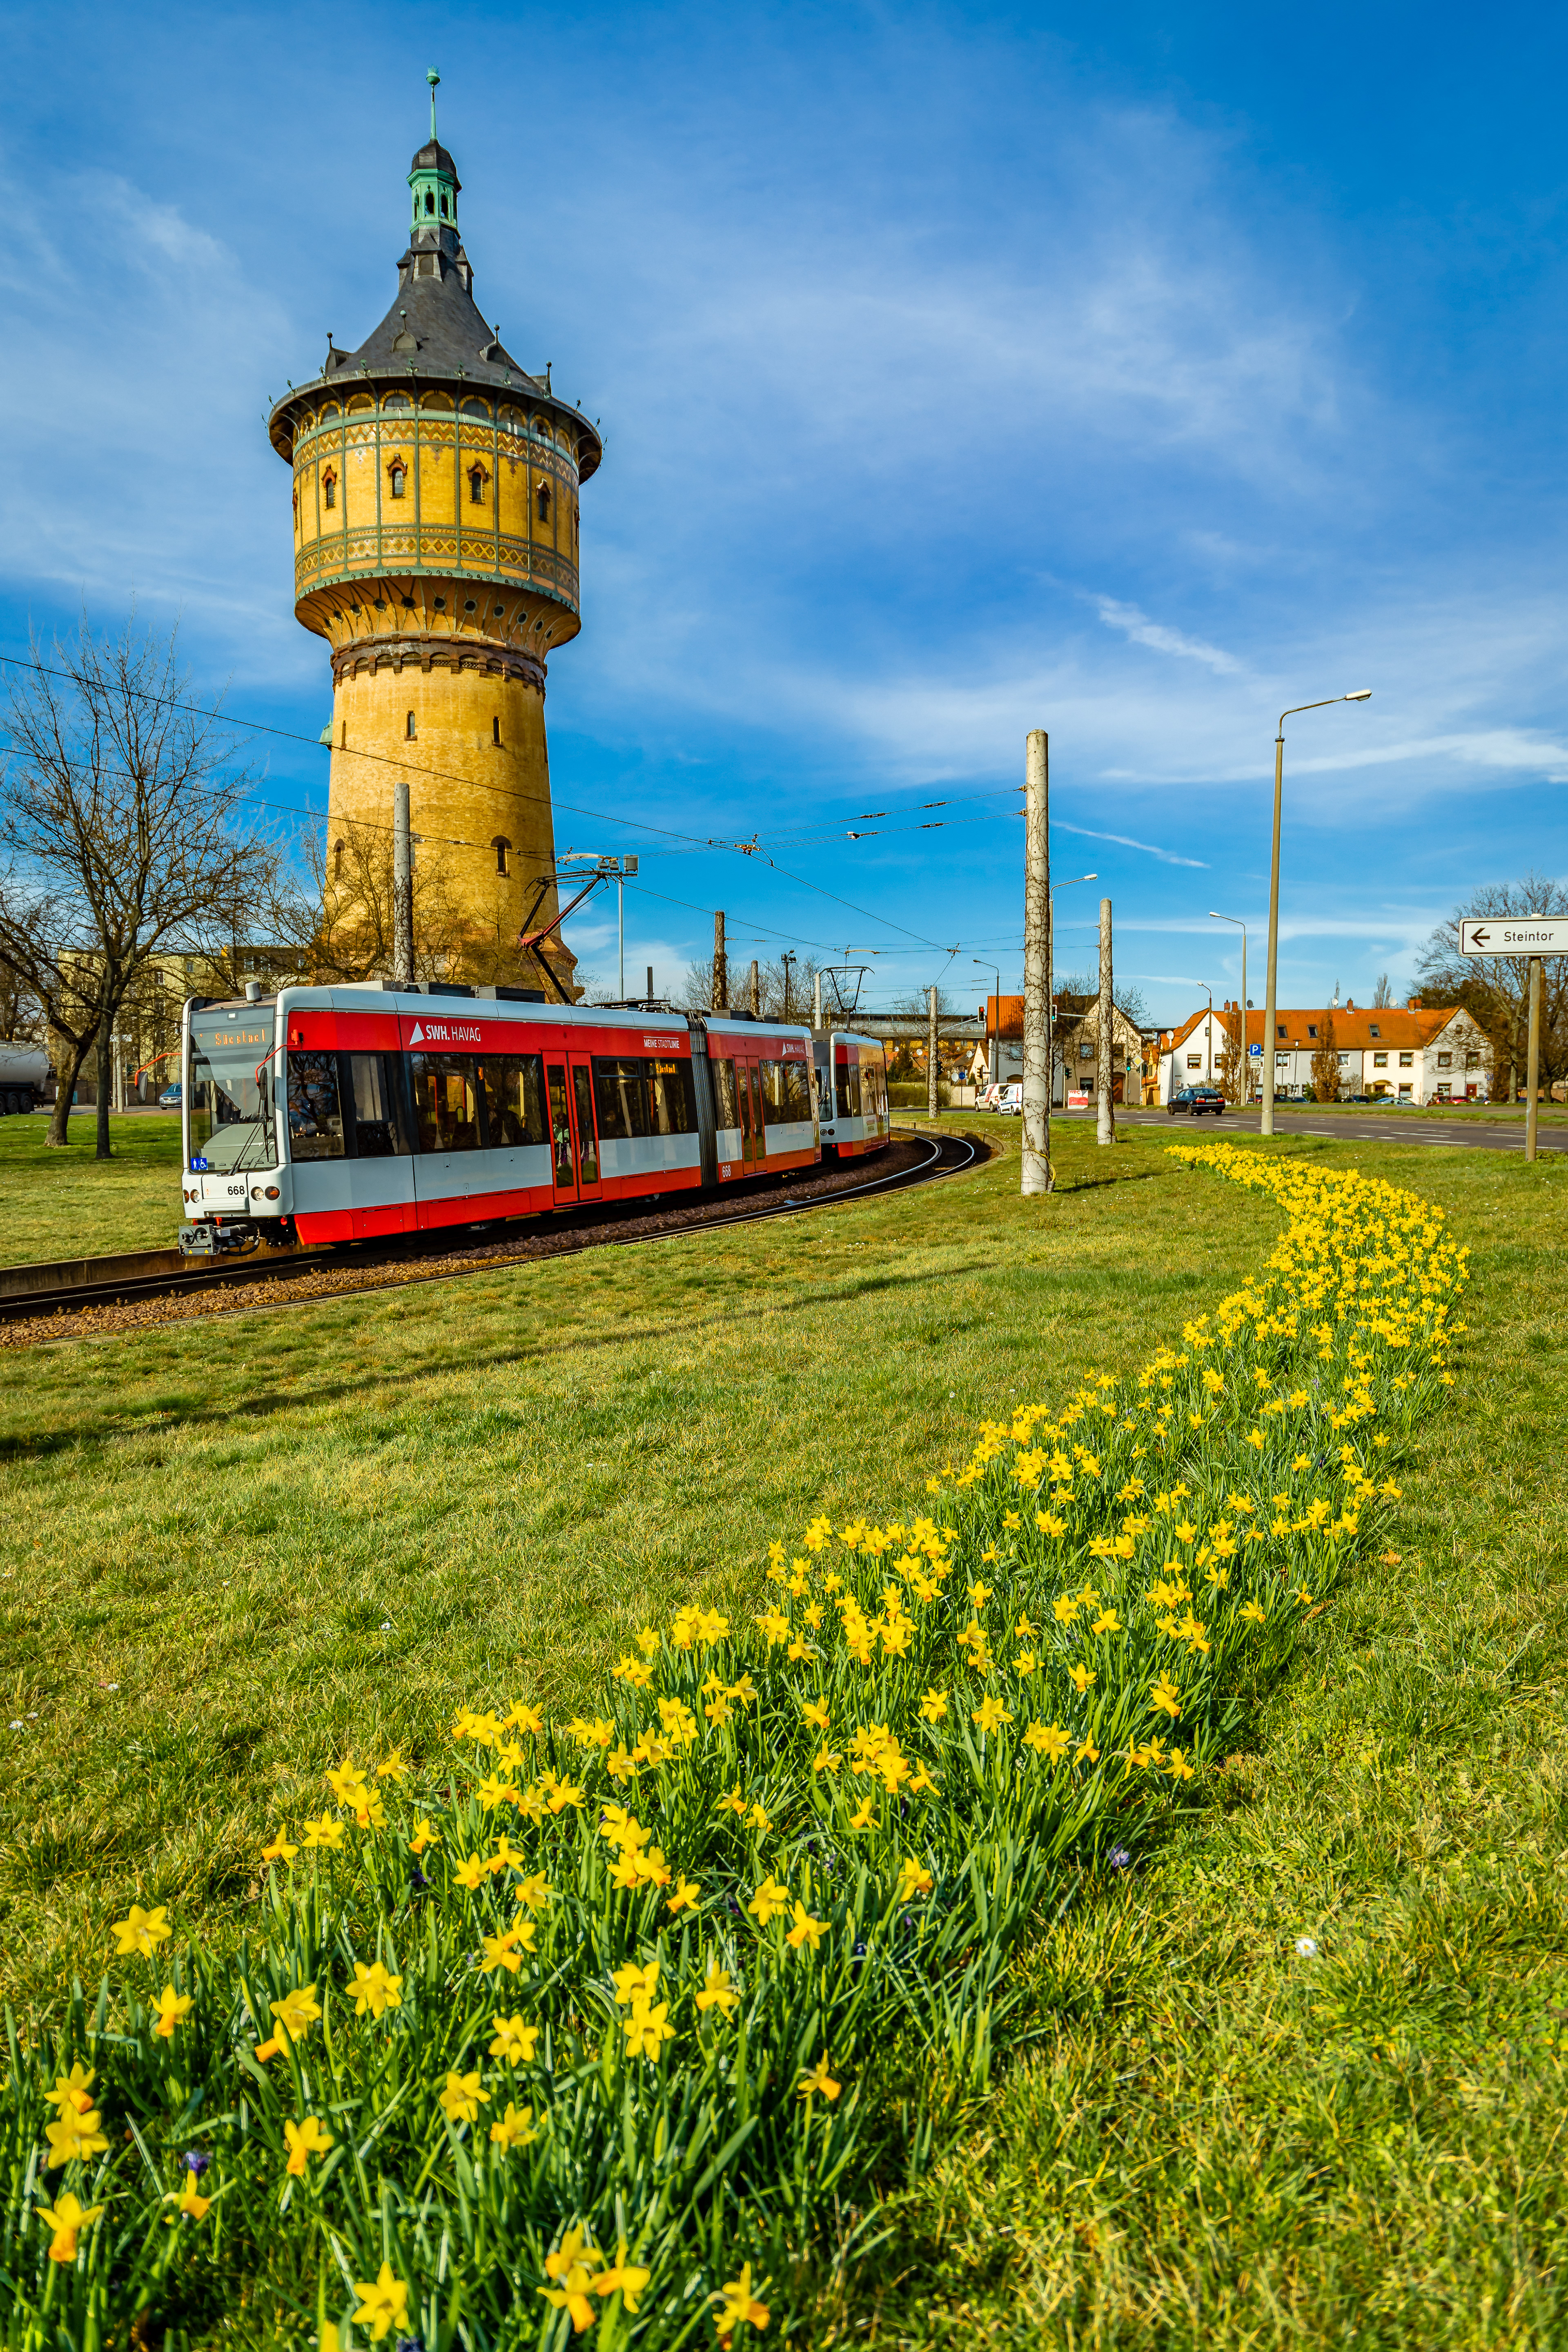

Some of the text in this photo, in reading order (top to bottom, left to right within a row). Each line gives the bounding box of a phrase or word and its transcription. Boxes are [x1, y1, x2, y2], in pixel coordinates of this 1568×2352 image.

[1504, 931, 1554, 942] Steintor
[426, 1025, 481, 1042] SWH. HAVAG
[644, 1039, 680, 1049] MEINE STADTLINIE
[1252, 1045, 1258, 1054] P
[722, 1165, 731, 1178] 668
[227, 1185, 245, 1195] 668
